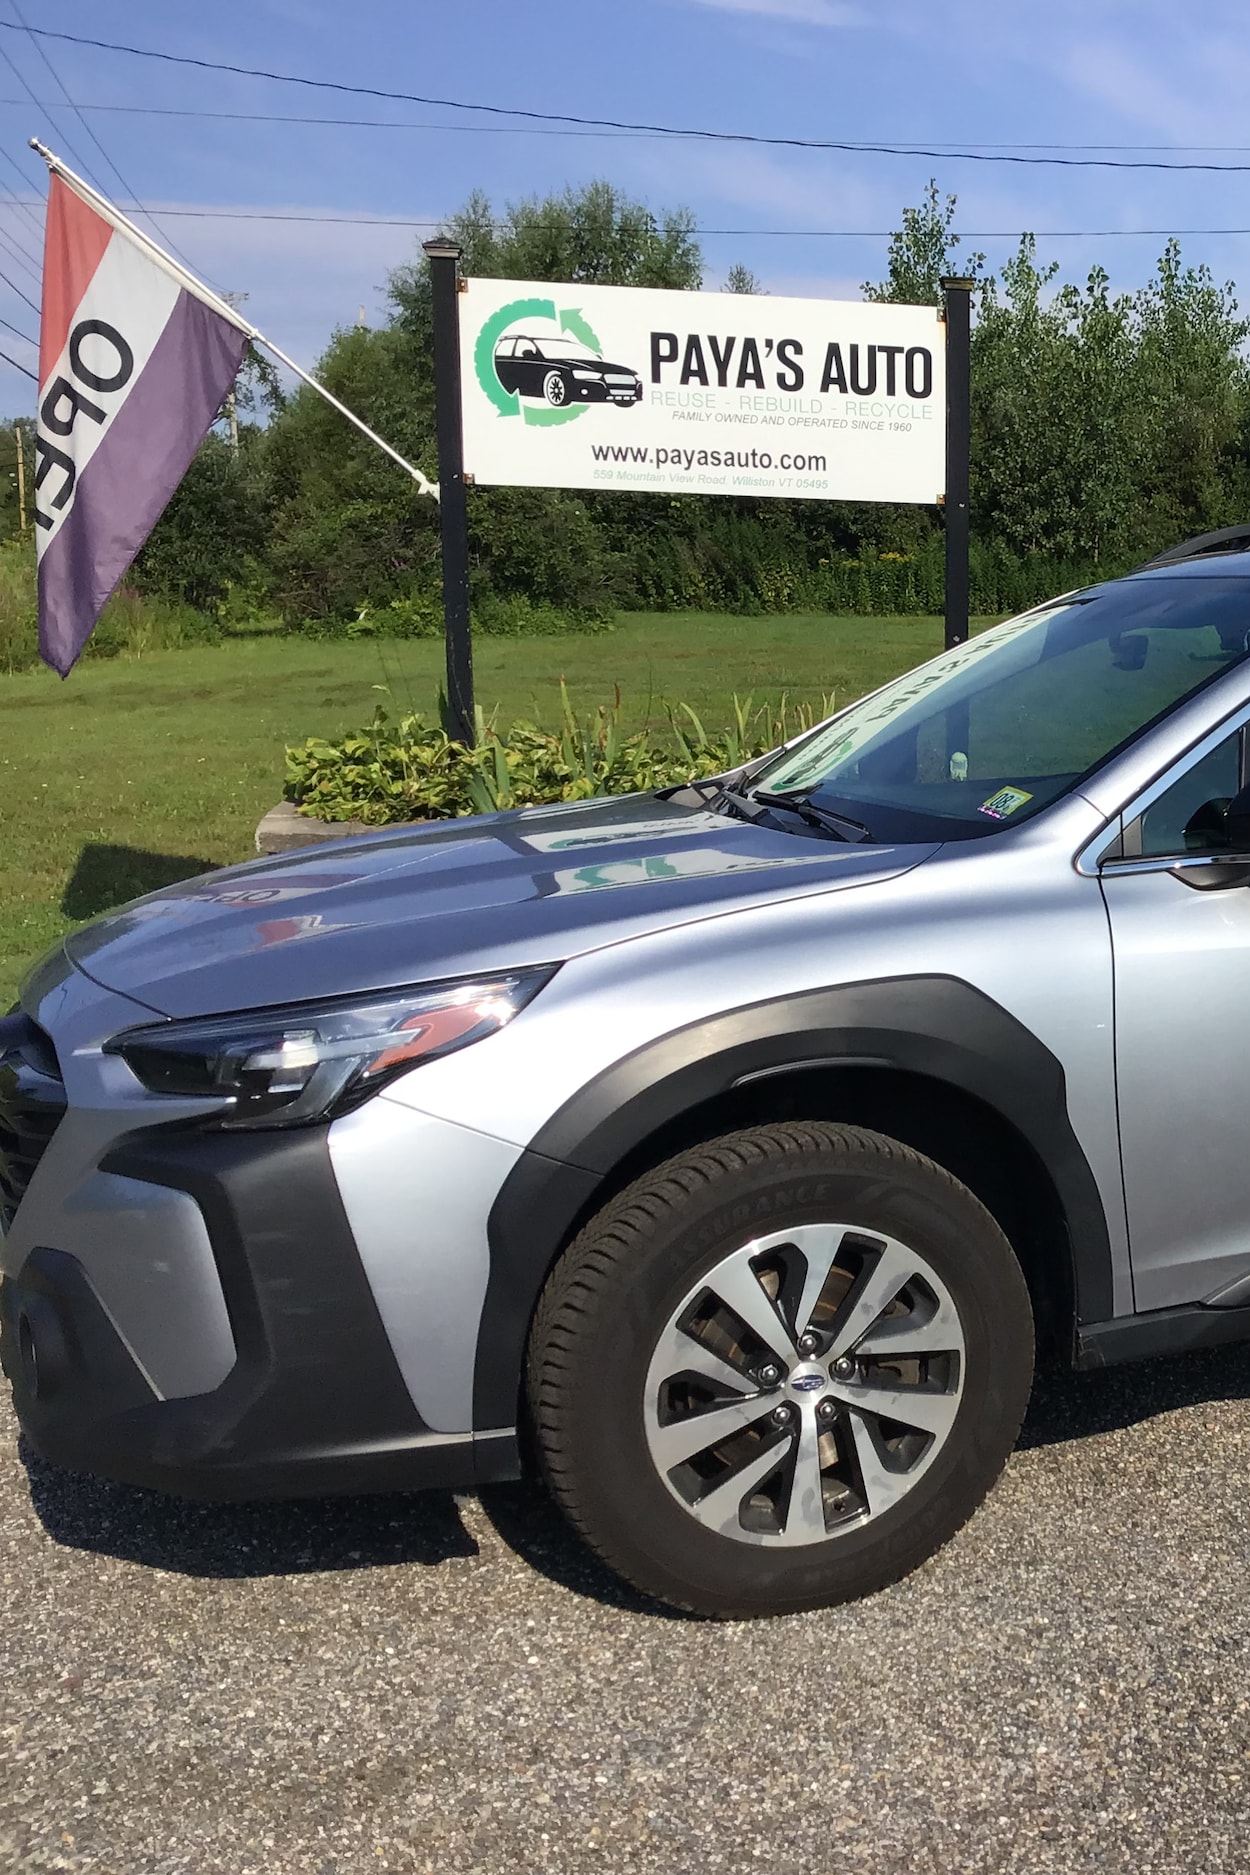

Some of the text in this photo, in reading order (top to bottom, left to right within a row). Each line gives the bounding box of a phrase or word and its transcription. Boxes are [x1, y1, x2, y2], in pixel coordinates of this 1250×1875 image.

[650, 331, 932, 399] PAYA'S AUTO
[651, 391, 716, 409] REUSE
[739, 395, 823, 414] REBUILD
[845, 401, 933, 420] RECYCLE
[672, 411, 912, 432] FAMILY OWNED AND OPERATED SINCE 1960
[591, 444, 827, 471] www.payasauto.com
[593, 470, 614, 480] 559
[617, 470, 665, 482] Mountain
[669, 473, 695, 484] View
[732, 475, 775, 488] Williston
[779, 478, 793, 488] VT
[796, 478, 829, 489] 05495
[990, 793, 1015, 809] 08
